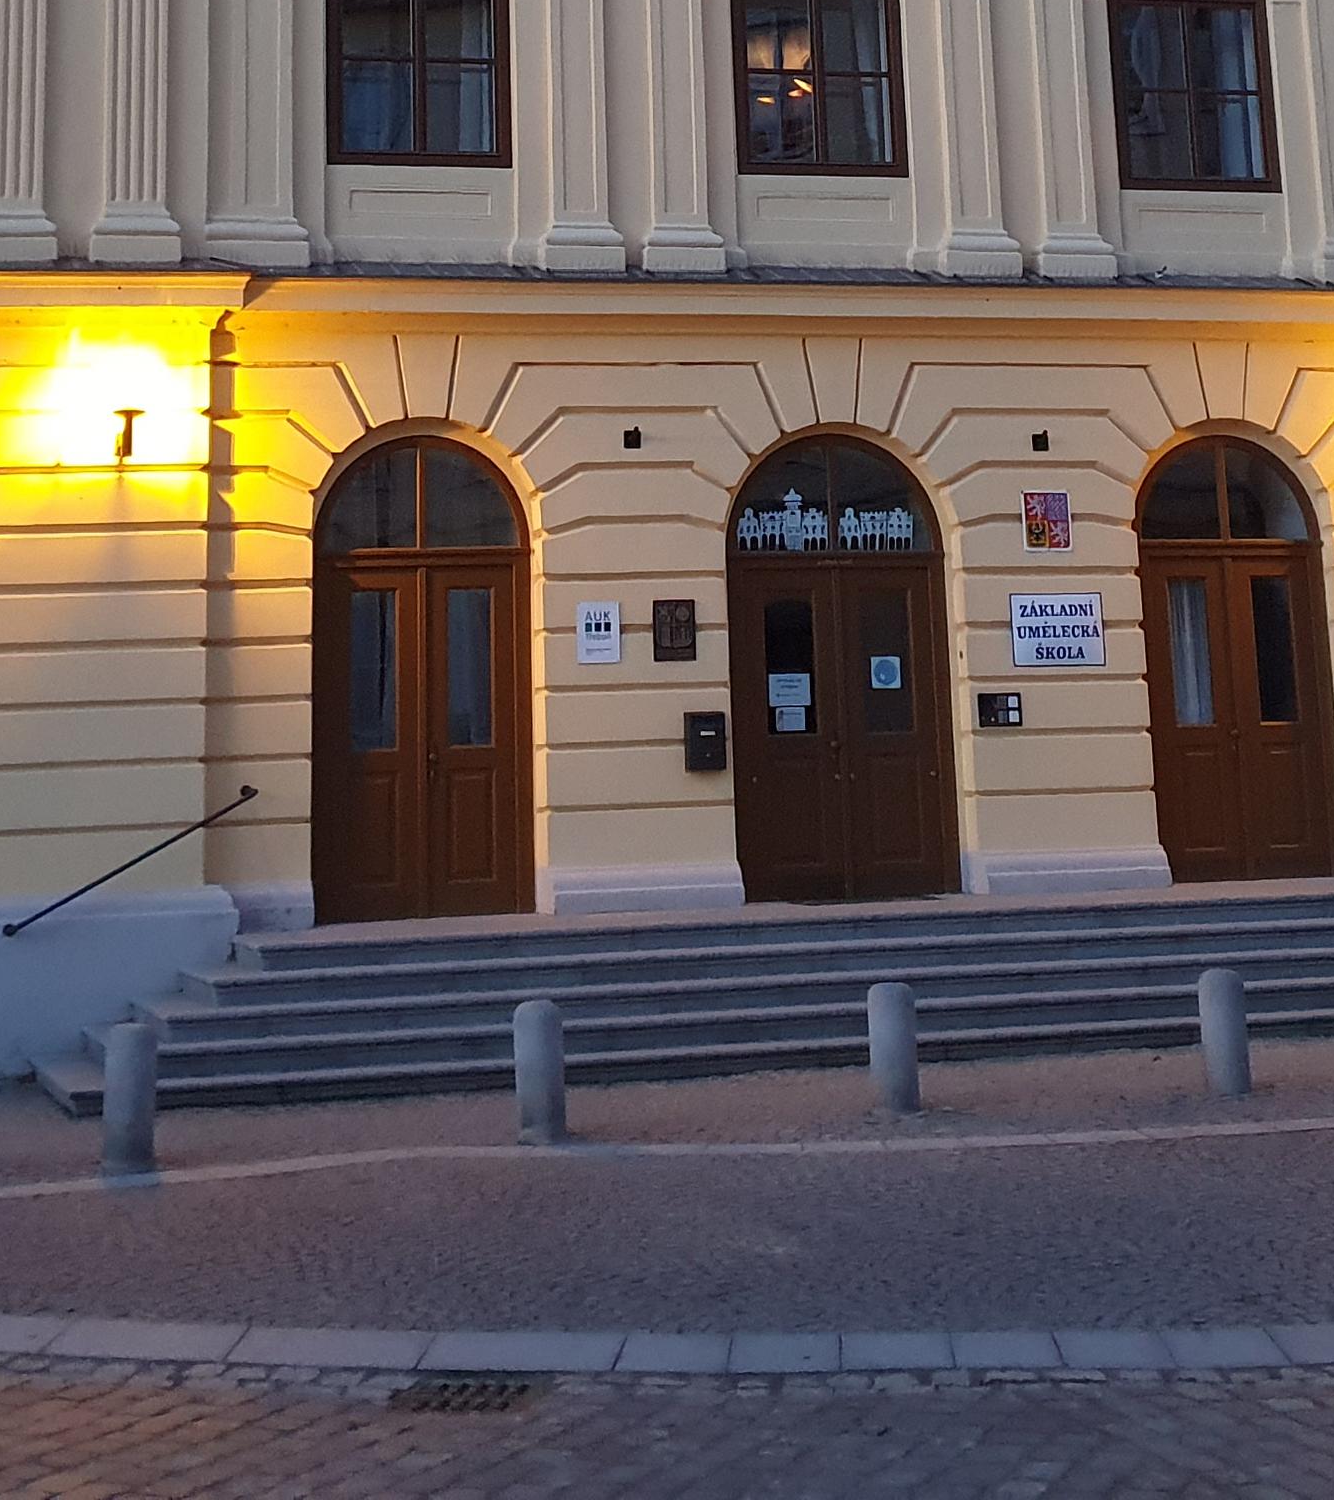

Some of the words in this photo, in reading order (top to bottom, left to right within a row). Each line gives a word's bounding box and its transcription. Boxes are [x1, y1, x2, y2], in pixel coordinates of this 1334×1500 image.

[585, 611, 611, 621] AUK
[1019, 600, 1094, 617] ZÁKLADNÍ
[1016, 621, 1100, 639] UMĚLECKÁ
[1035, 642, 1085, 660] ŠKOLA
